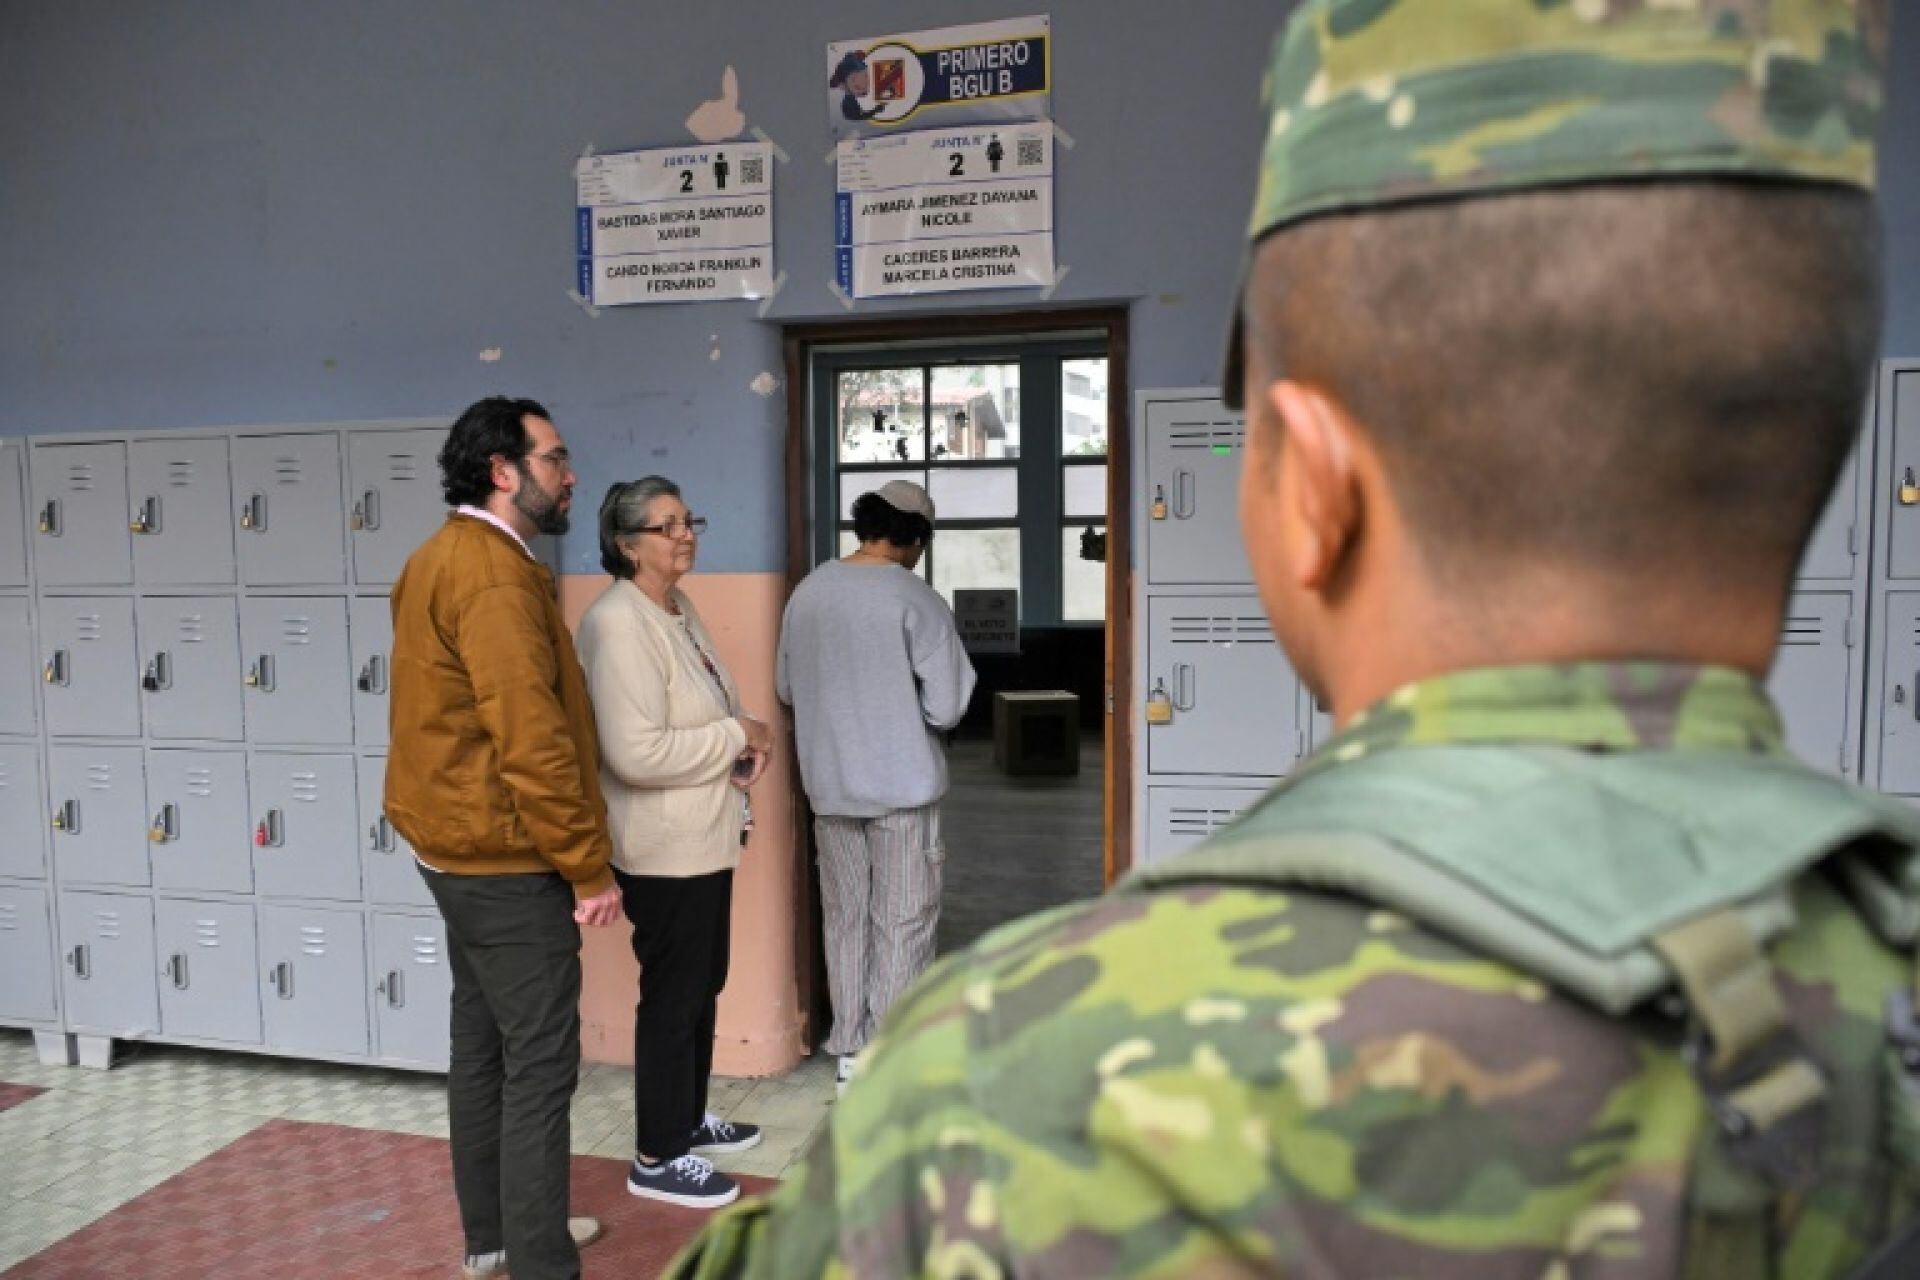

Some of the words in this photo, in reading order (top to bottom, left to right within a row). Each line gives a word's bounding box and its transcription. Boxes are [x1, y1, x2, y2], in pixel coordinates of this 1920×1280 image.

[937, 41, 1029, 75] PRIMERO
[949, 72, 992, 99] BGU
[999, 70, 1013, 93] B
[949, 153, 965, 175] 2
[680, 170, 693, 193] 2
[862, 199, 915, 215] AYMARA
[919, 192, 978, 207] JIMENEZ
[982, 189, 1038, 205] DAYANA
[597, 214, 657, 229] BASTIDAS
[699, 205, 765, 220] SANTIAGO
[922, 213, 972, 227] NICOLE
[657, 227, 701, 240] XAVIER
[884, 249, 948, 266] CACERES
[952, 245, 1021, 262] BARRERA
[606, 264, 649, 280] CANDO
[699, 257, 761, 271] FRANKLIN
[884, 267, 948, 283] MARCELA
[952, 264, 1016, 280] CRISTINA
[647, 277, 715, 293] FERNANDO
